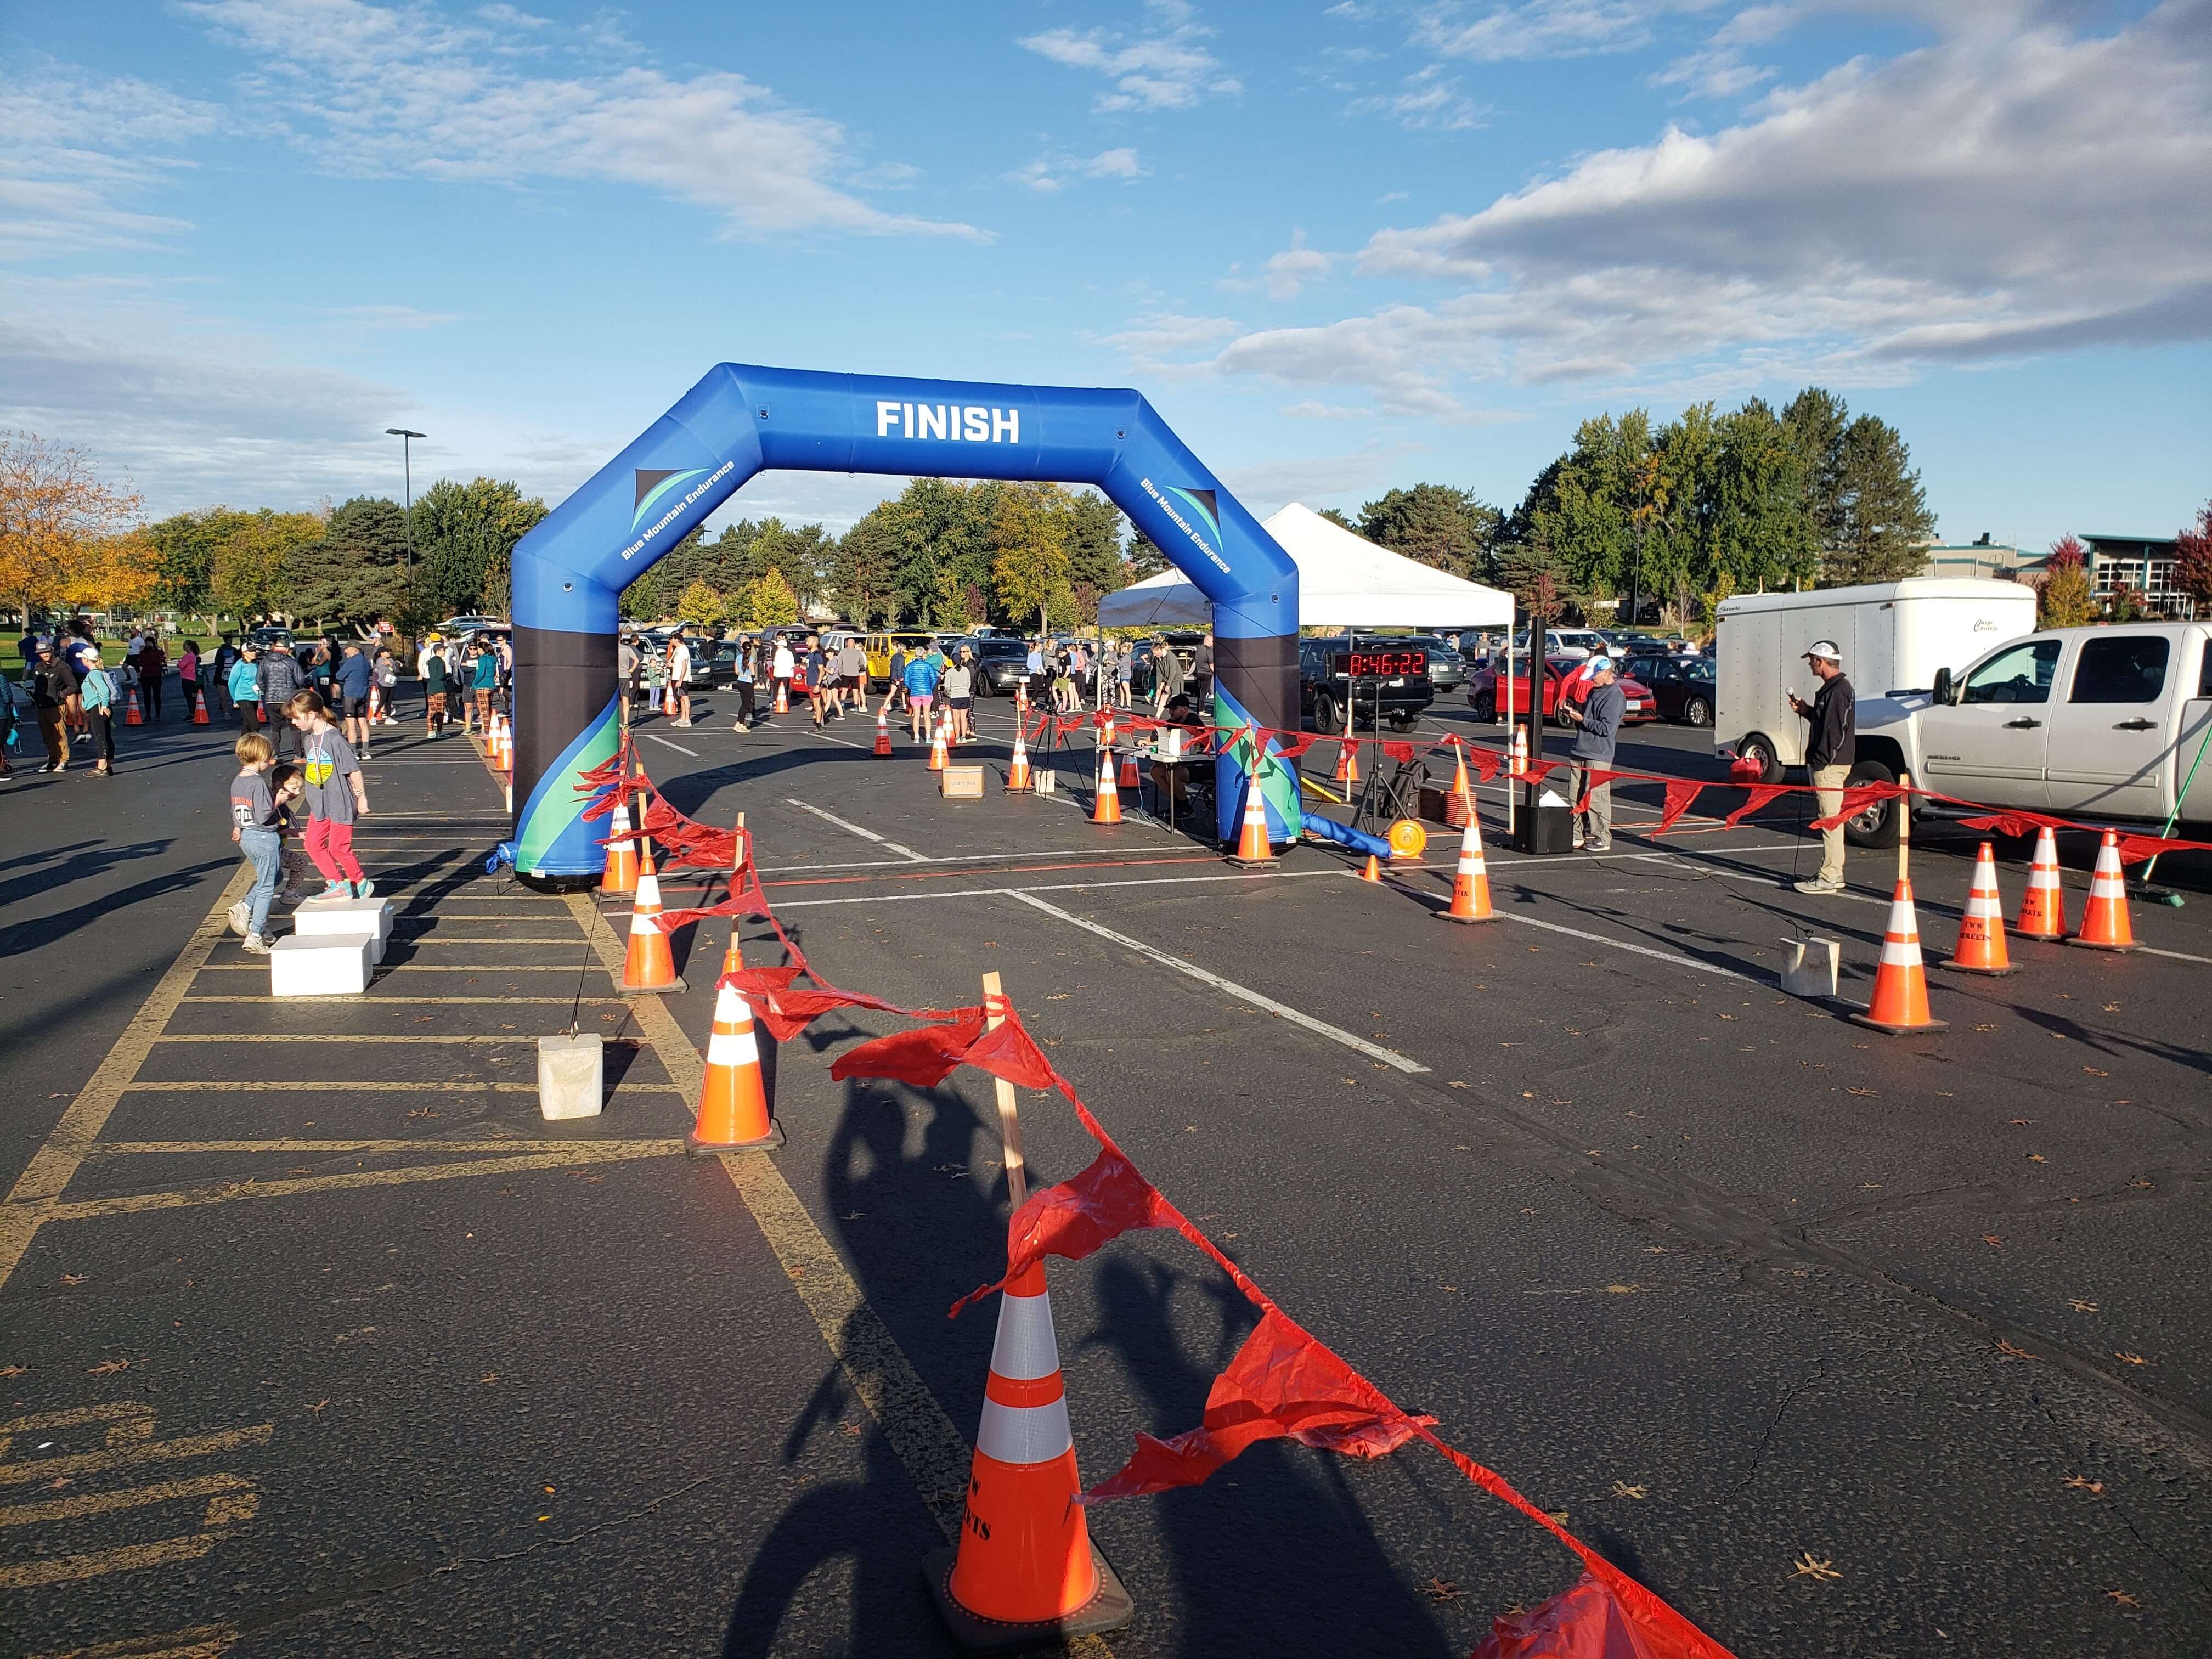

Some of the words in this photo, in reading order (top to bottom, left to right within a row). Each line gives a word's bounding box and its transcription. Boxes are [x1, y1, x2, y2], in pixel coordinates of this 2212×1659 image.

[876, 401, 1020, 444] FINISH
[620, 536, 645, 561] Blue
[643, 501, 688, 543] Mountain
[685, 460, 736, 505] Endurance
[1140, 478, 1160, 500] Blue
[1156, 496, 1193, 536] Mountain
[1190, 531, 1231, 574] Endurance
